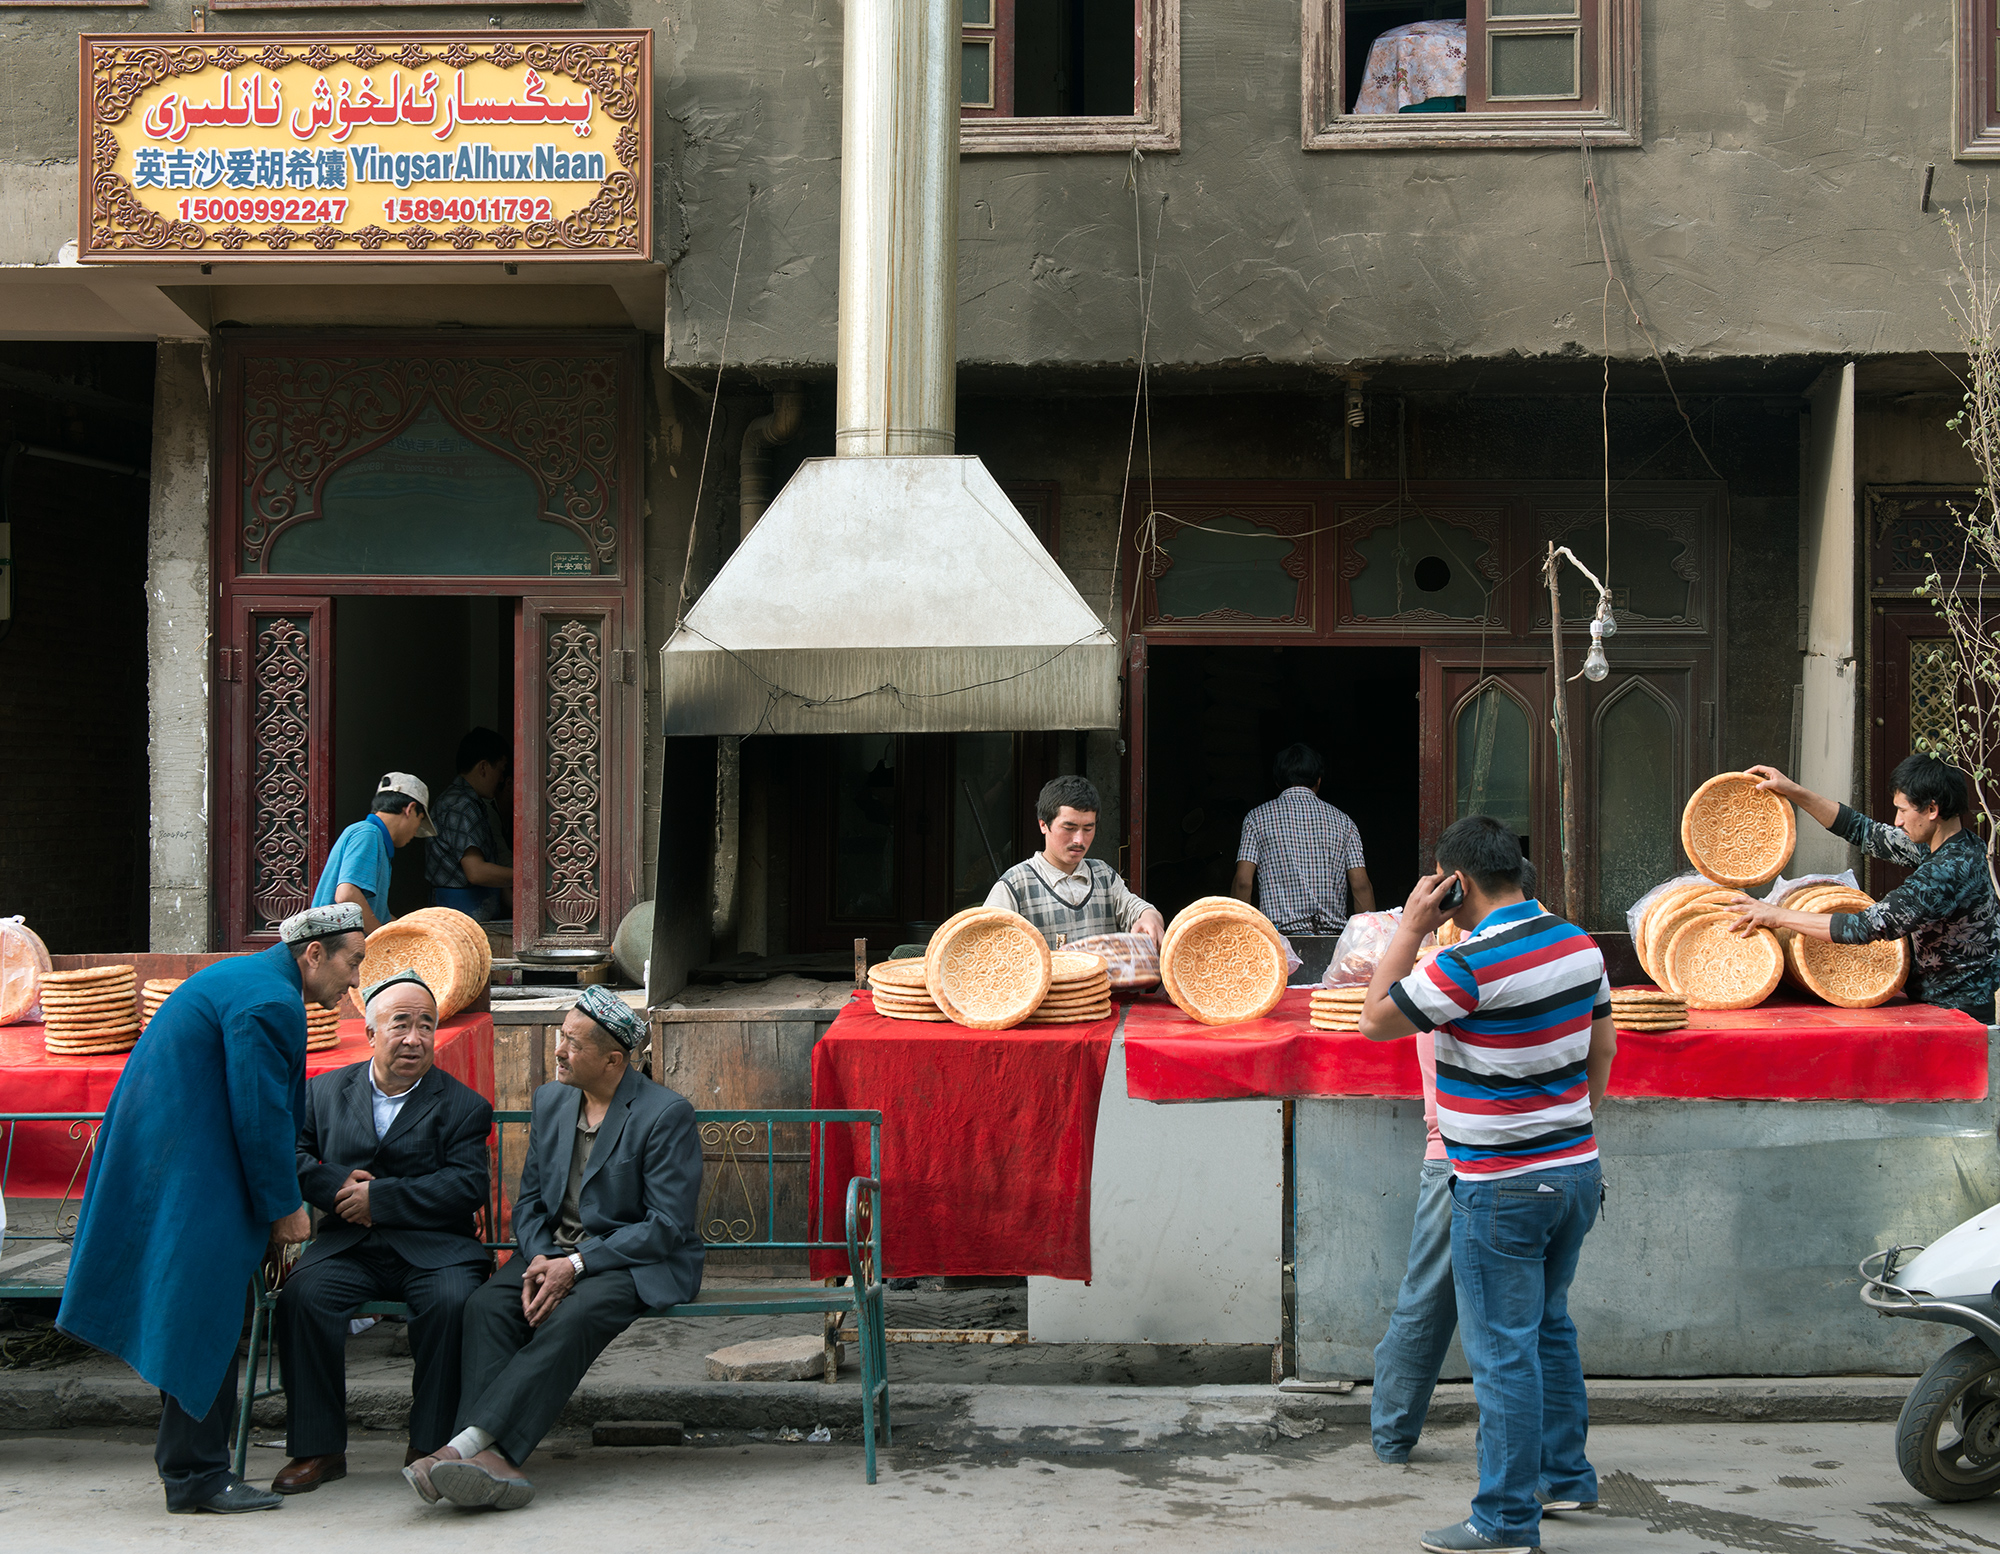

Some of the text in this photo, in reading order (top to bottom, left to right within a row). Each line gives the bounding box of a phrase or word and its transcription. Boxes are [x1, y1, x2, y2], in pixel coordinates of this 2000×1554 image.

[144, 73, 281, 142] نانلىرى
[135, 147, 346, 188] 英吉沙爱胡希馕
[535, 145, 604, 179] Naan
[179, 199, 550, 221] 15009992247 15894011792
